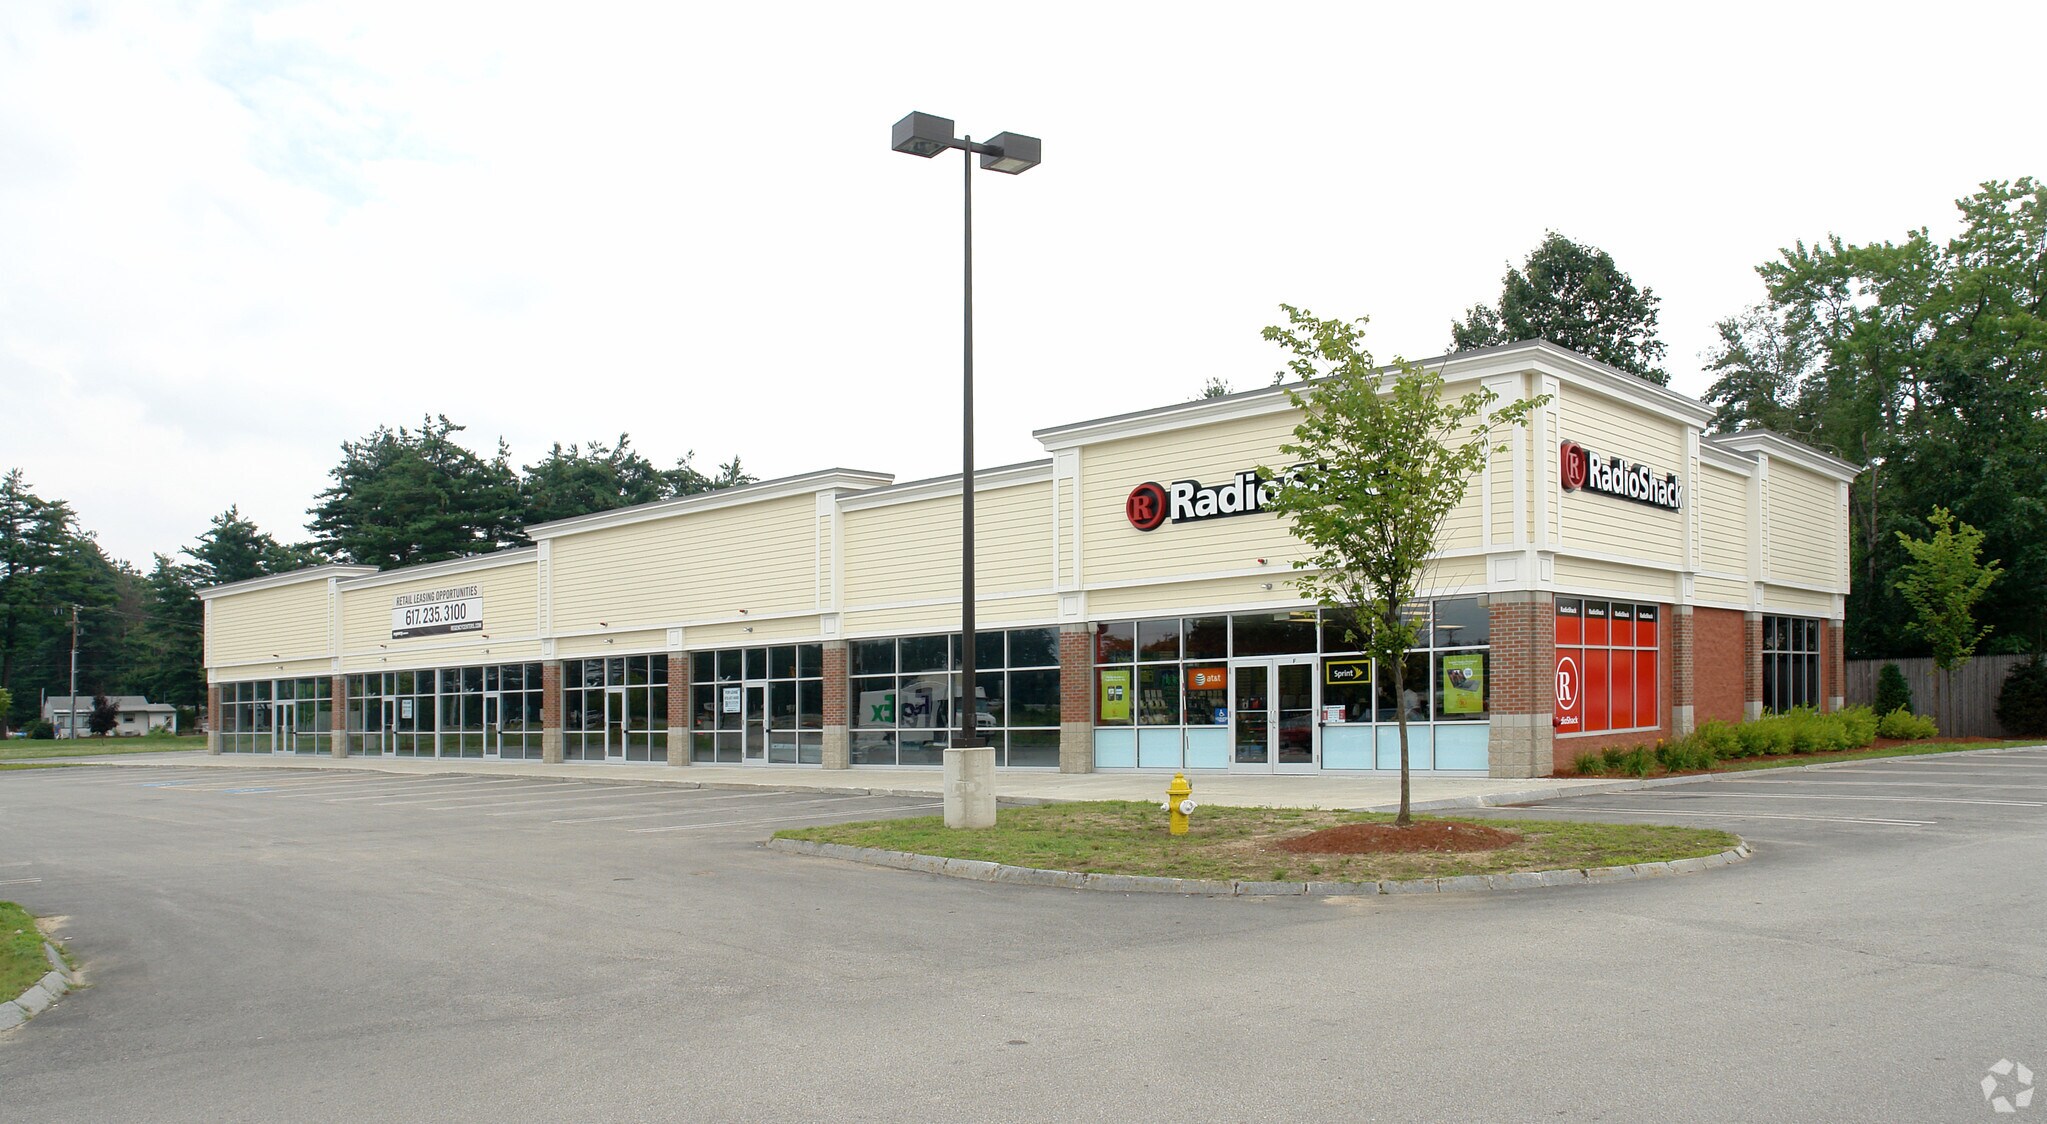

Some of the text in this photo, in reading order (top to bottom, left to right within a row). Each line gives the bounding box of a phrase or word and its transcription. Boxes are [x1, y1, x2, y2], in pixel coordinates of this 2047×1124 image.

[1170, 458, 1388, 520] RadioS
[1589, 450, 1684, 510] RadioShack
[396, 585, 478, 606] RETAIL LEASING OPPORTUNITIES
[405, 602, 467, 626] 617.235.3100
[1206, 674, 1222, 683] at&t
[1333, 669, 1354, 679] Sprint
